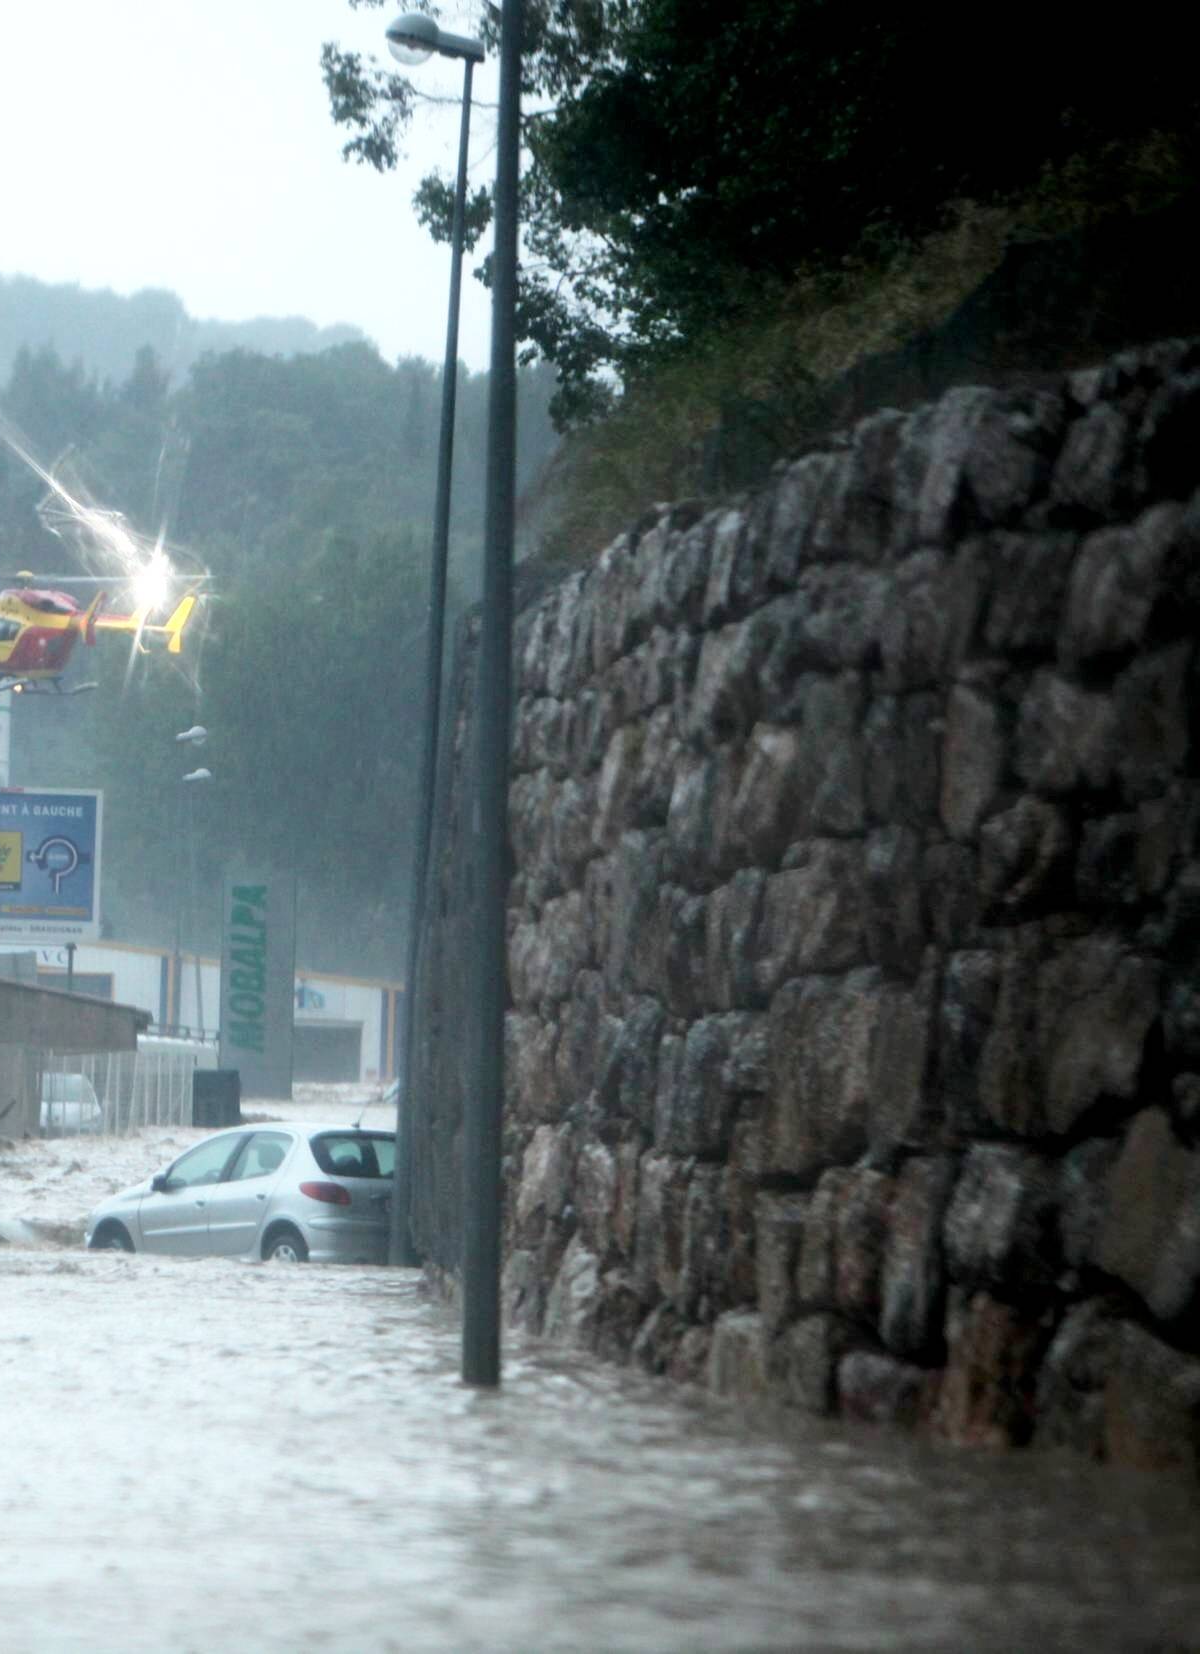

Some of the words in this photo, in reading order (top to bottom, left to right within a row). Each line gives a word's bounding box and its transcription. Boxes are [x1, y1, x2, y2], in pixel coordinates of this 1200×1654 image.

[21, 803, 30, 816] À
[33, 806, 83, 818] GAUCHE
[228, 885, 267, 1053] MOBALPA
